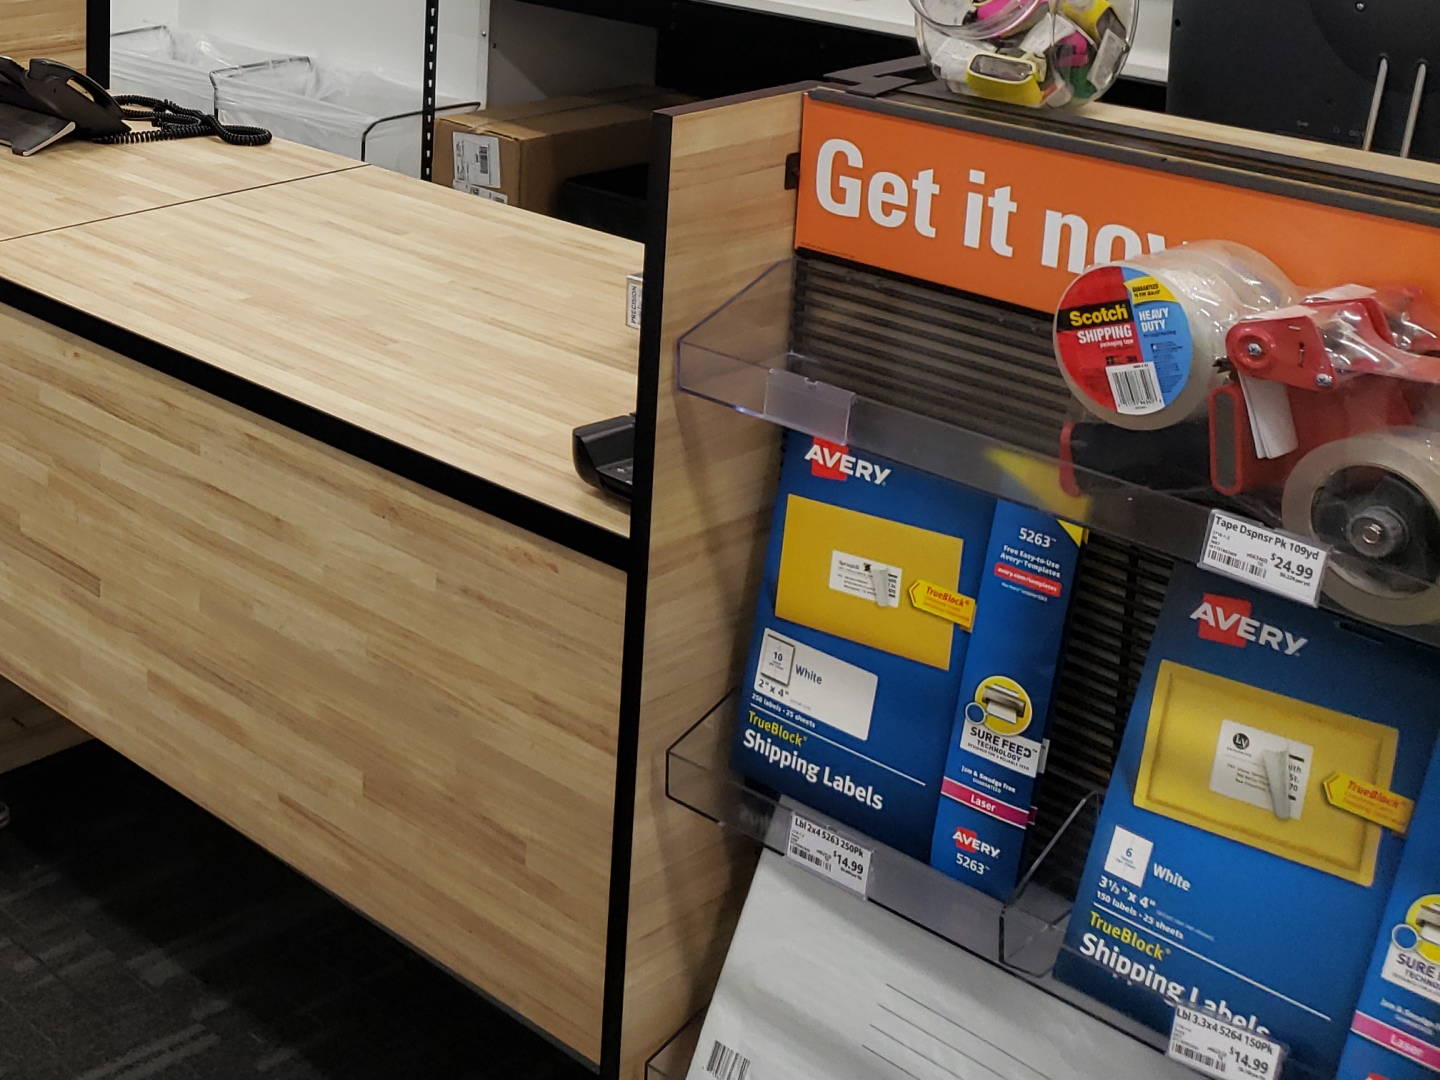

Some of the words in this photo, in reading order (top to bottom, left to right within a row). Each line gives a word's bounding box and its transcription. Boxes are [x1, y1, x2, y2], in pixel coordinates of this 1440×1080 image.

[815, 138, 939, 239] Get
[964, 169, 1018, 258] it
[1041, 209, 1187, 275] no
[1069, 304, 1129, 327] Scotch
[1138, 307, 1169, 321] HEAVY
[1141, 319, 1166, 333] DUTY
[1077, 324, 1133, 344] SHIPPING
[804, 445, 892, 484] AVERY
[1215, 516, 1239, 532] Tape
[1240, 525, 1273, 544] Dspnsr
[1275, 537, 1287, 549] Pk
[1289, 542, 1320, 561] 109yd
[1003, 545, 1019, 556] Free
[1019, 550, 1060, 570] Easy-to-Use
[1024, 560, 1061, 578] Templates
[1270, 553, 1314, 580] $24.99
[1190, 601, 1308, 656] AVERY
[773, 651, 783, 662] 10
[795, 664, 823, 685] White
[751, 692, 763, 703] 250
[764, 697, 782, 713] labels
[795, 713, 816, 728] sheets
[970, 726, 1001, 747] SURE
[976, 739, 1022, 762] TECHNOLOGY
[743, 729, 821, 783] Shipping
[823, 766, 883, 810] Labels
[970, 794, 996, 813] Laser
[795, 817, 807, 830] Lbl
[807, 823, 821, 837] 2x4
[821, 830, 840, 846] 5263
[841, 839, 864, 858] 250Pk
[952, 831, 1001, 858] AVERY
[833, 850, 864, 875] $14.99
[1125, 847, 1133, 858] 6
[1153, 863, 1192, 892] White
[1097, 890, 1111, 903] 150
[1112, 896, 1137, 917] labels
[1143, 913, 1155, 925] 25
[1155, 919, 1185, 940] sheets
[1080, 932, 1186, 1007] Shipping
[1396, 952, 1435, 978] SURE
[1176, 1008, 1191, 1020] Lbl
[1193, 1014, 1218, 1033] 3.3x4
[1219, 1026, 1242, 1041] 5264
[1245, 1035, 1273, 1056] 150Pk
[1229, 1046, 1269, 1074] $14.99
